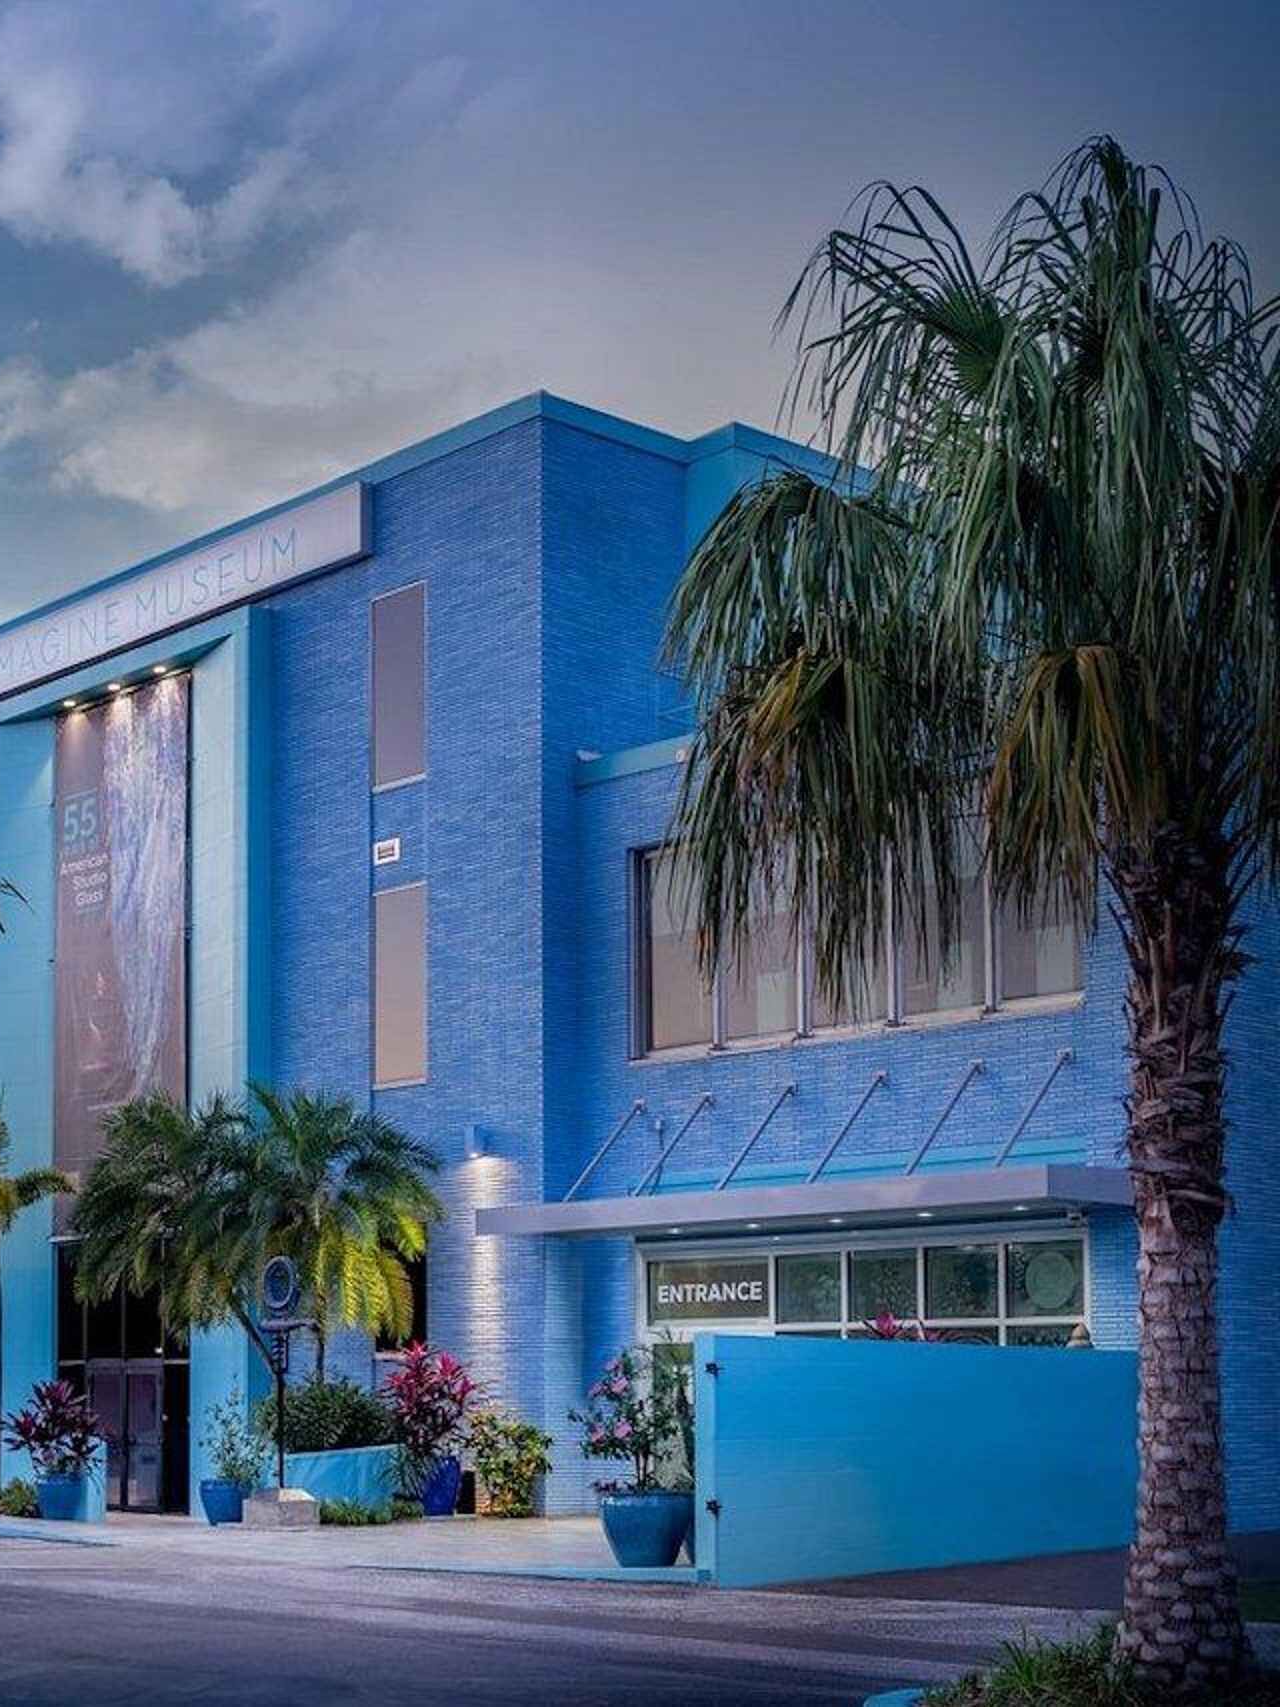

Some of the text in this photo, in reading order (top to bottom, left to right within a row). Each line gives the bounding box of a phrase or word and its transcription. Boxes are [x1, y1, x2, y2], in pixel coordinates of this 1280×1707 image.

[135, 527, 298, 626] MUSEUM
[63, 798, 97, 841] 55
[657, 1281, 763, 1303] ENTRANCE
